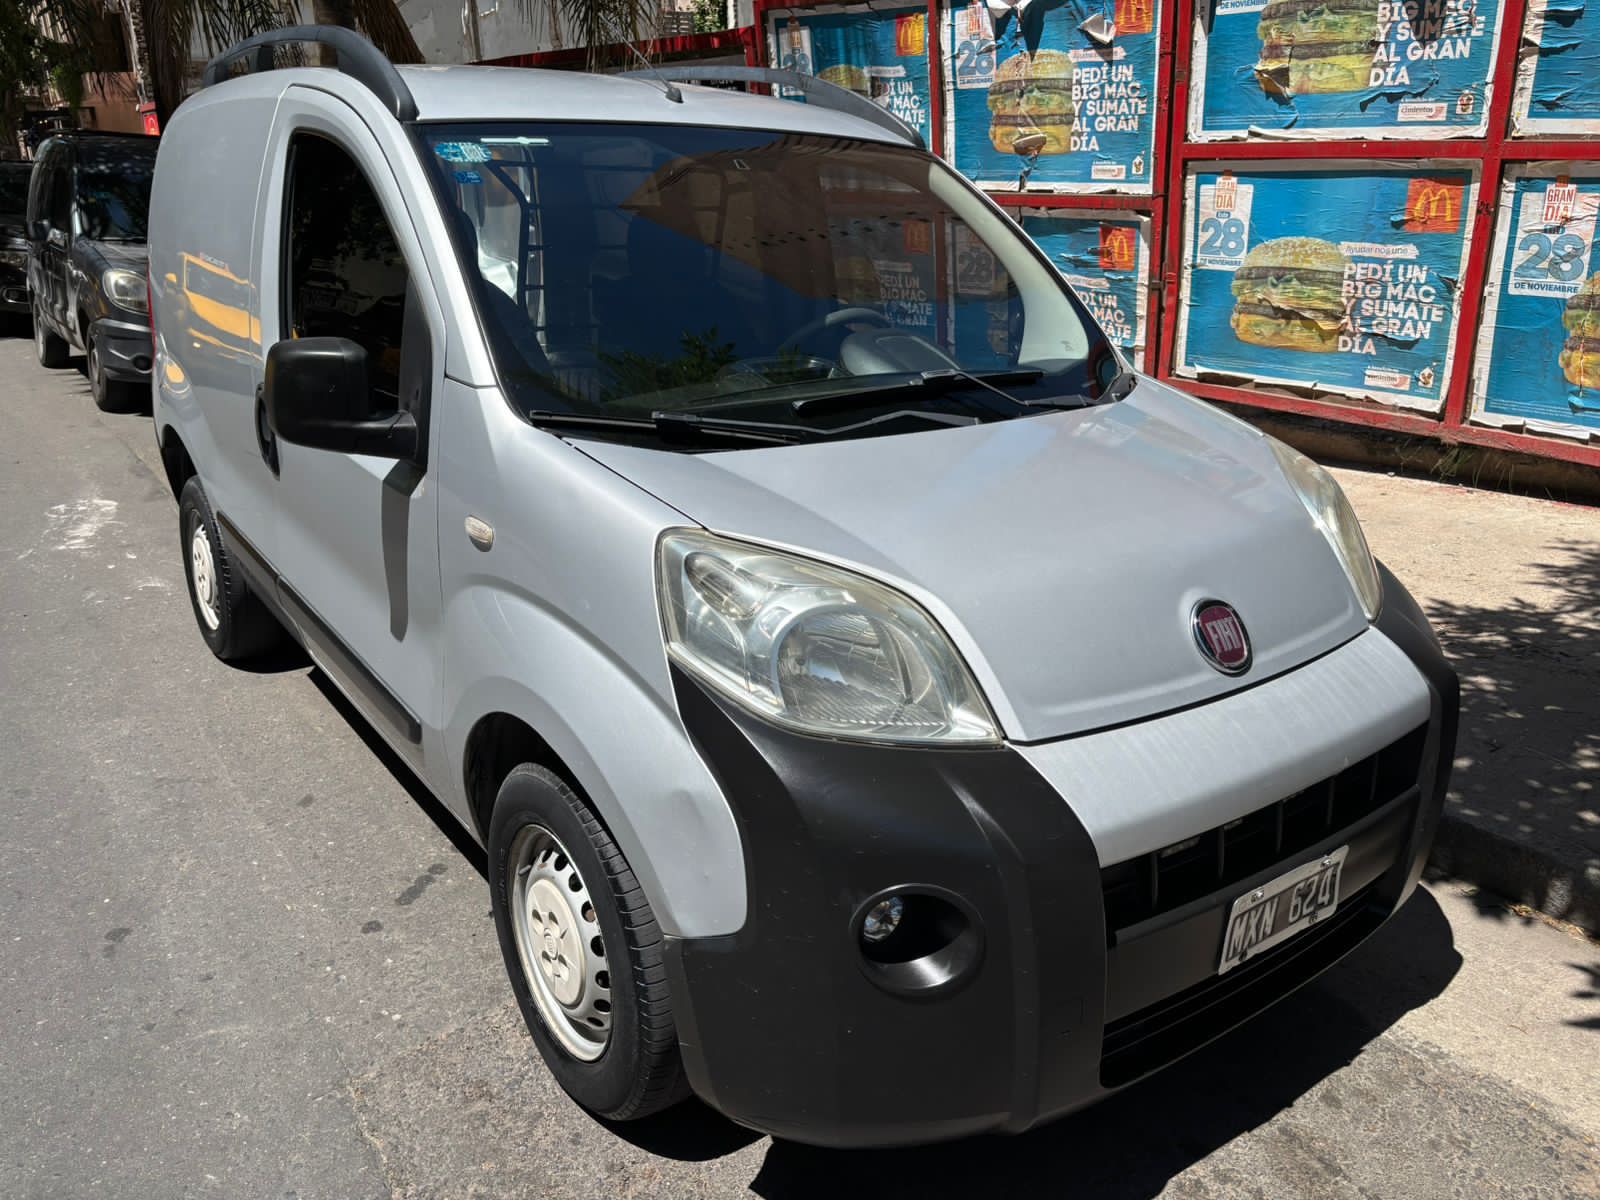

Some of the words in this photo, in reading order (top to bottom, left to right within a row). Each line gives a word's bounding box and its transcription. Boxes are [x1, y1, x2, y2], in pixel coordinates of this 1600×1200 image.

[1377, 1, 1418, 22] BIG
[1376, 22, 1392, 41] Y
[1373, 41, 1401, 62] AL
[1406, 38, 1471, 60] GRAN
[1072, 63, 1109, 83] PEDÍ
[1111, 65, 1133, 81] UN
[1369, 62, 1410, 86] DÍA
[897, 81, 913, 95] UN
[1071, 83, 1101, 100] BIG
[1104, 82, 1140, 98] MAC
[893, 95, 920, 110] MAC
[1071, 101, 1082, 118] Y
[1086, 98, 1147, 116] SUMATE
[1071, 117, 1091, 132] AL
[1094, 116, 1139, 131] GRAN
[1070, 133, 1099, 151] DÍA
[1547, 188, 1574, 202] GRAN
[1200, 218, 1245, 256] 28
[1514, 233, 1586, 282] 28
[1344, 260, 1394, 282] PEDÍ
[1398, 264, 1427, 284] UN
[1342, 280, 1382, 298] BIG
[1386, 282, 1436, 303] MAC
[1527, 283, 1580, 294] NOVIEMBRE
[1094, 307, 1126, 323] MAC
[1341, 297, 1356, 315] Y
[1361, 299, 1444, 322] SUMATE
[1372, 317, 1431, 340] GRAN
[1338, 334, 1377, 356] DÍA
[1205, 617, 1242, 655] FIAT
[1228, 896, 1279, 959] MXN
[1288, 866, 1333, 923] 624
